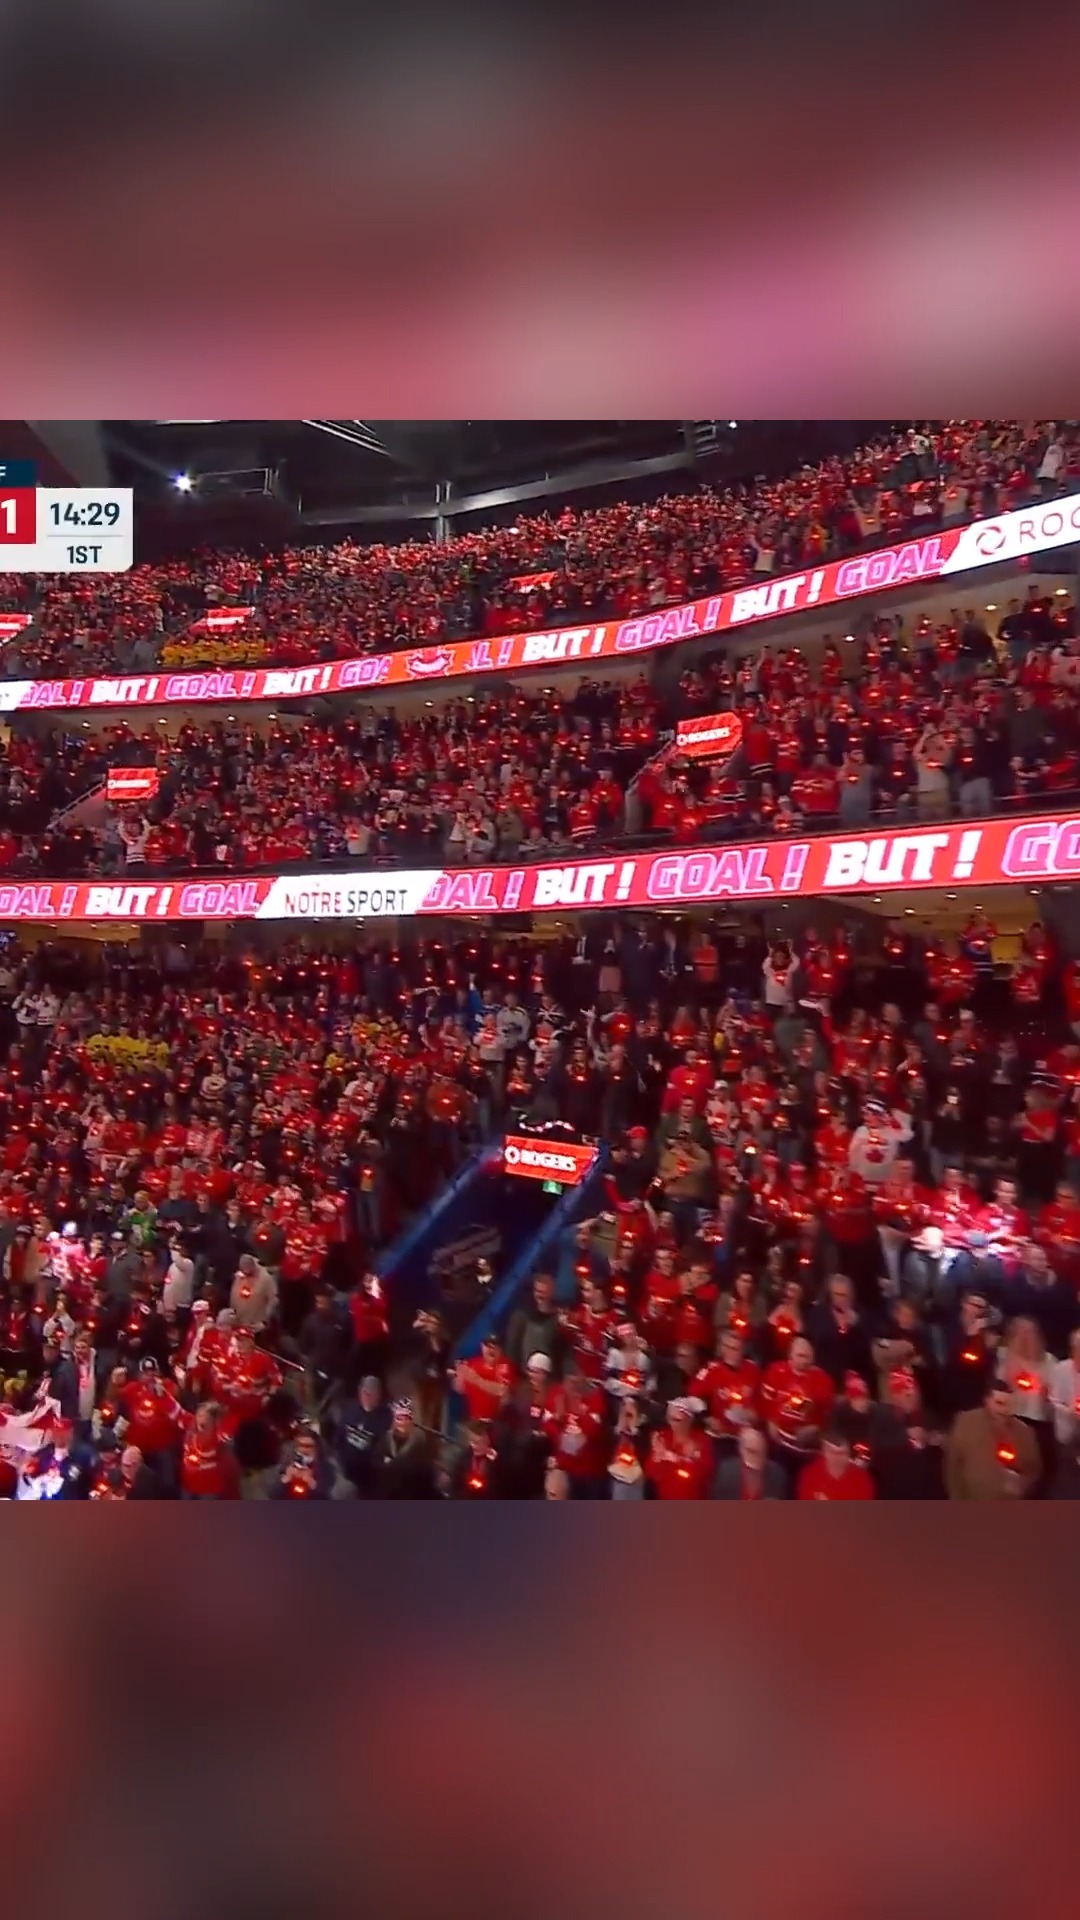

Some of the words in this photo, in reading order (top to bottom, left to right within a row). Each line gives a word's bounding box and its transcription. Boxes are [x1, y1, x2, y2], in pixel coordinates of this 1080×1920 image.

[835, 538, 945, 596] GOAL
[179, 882, 262, 917] GOAL
[347, 889, 408, 913] SPORT
[520, 1149, 577, 1172] ROGERS
